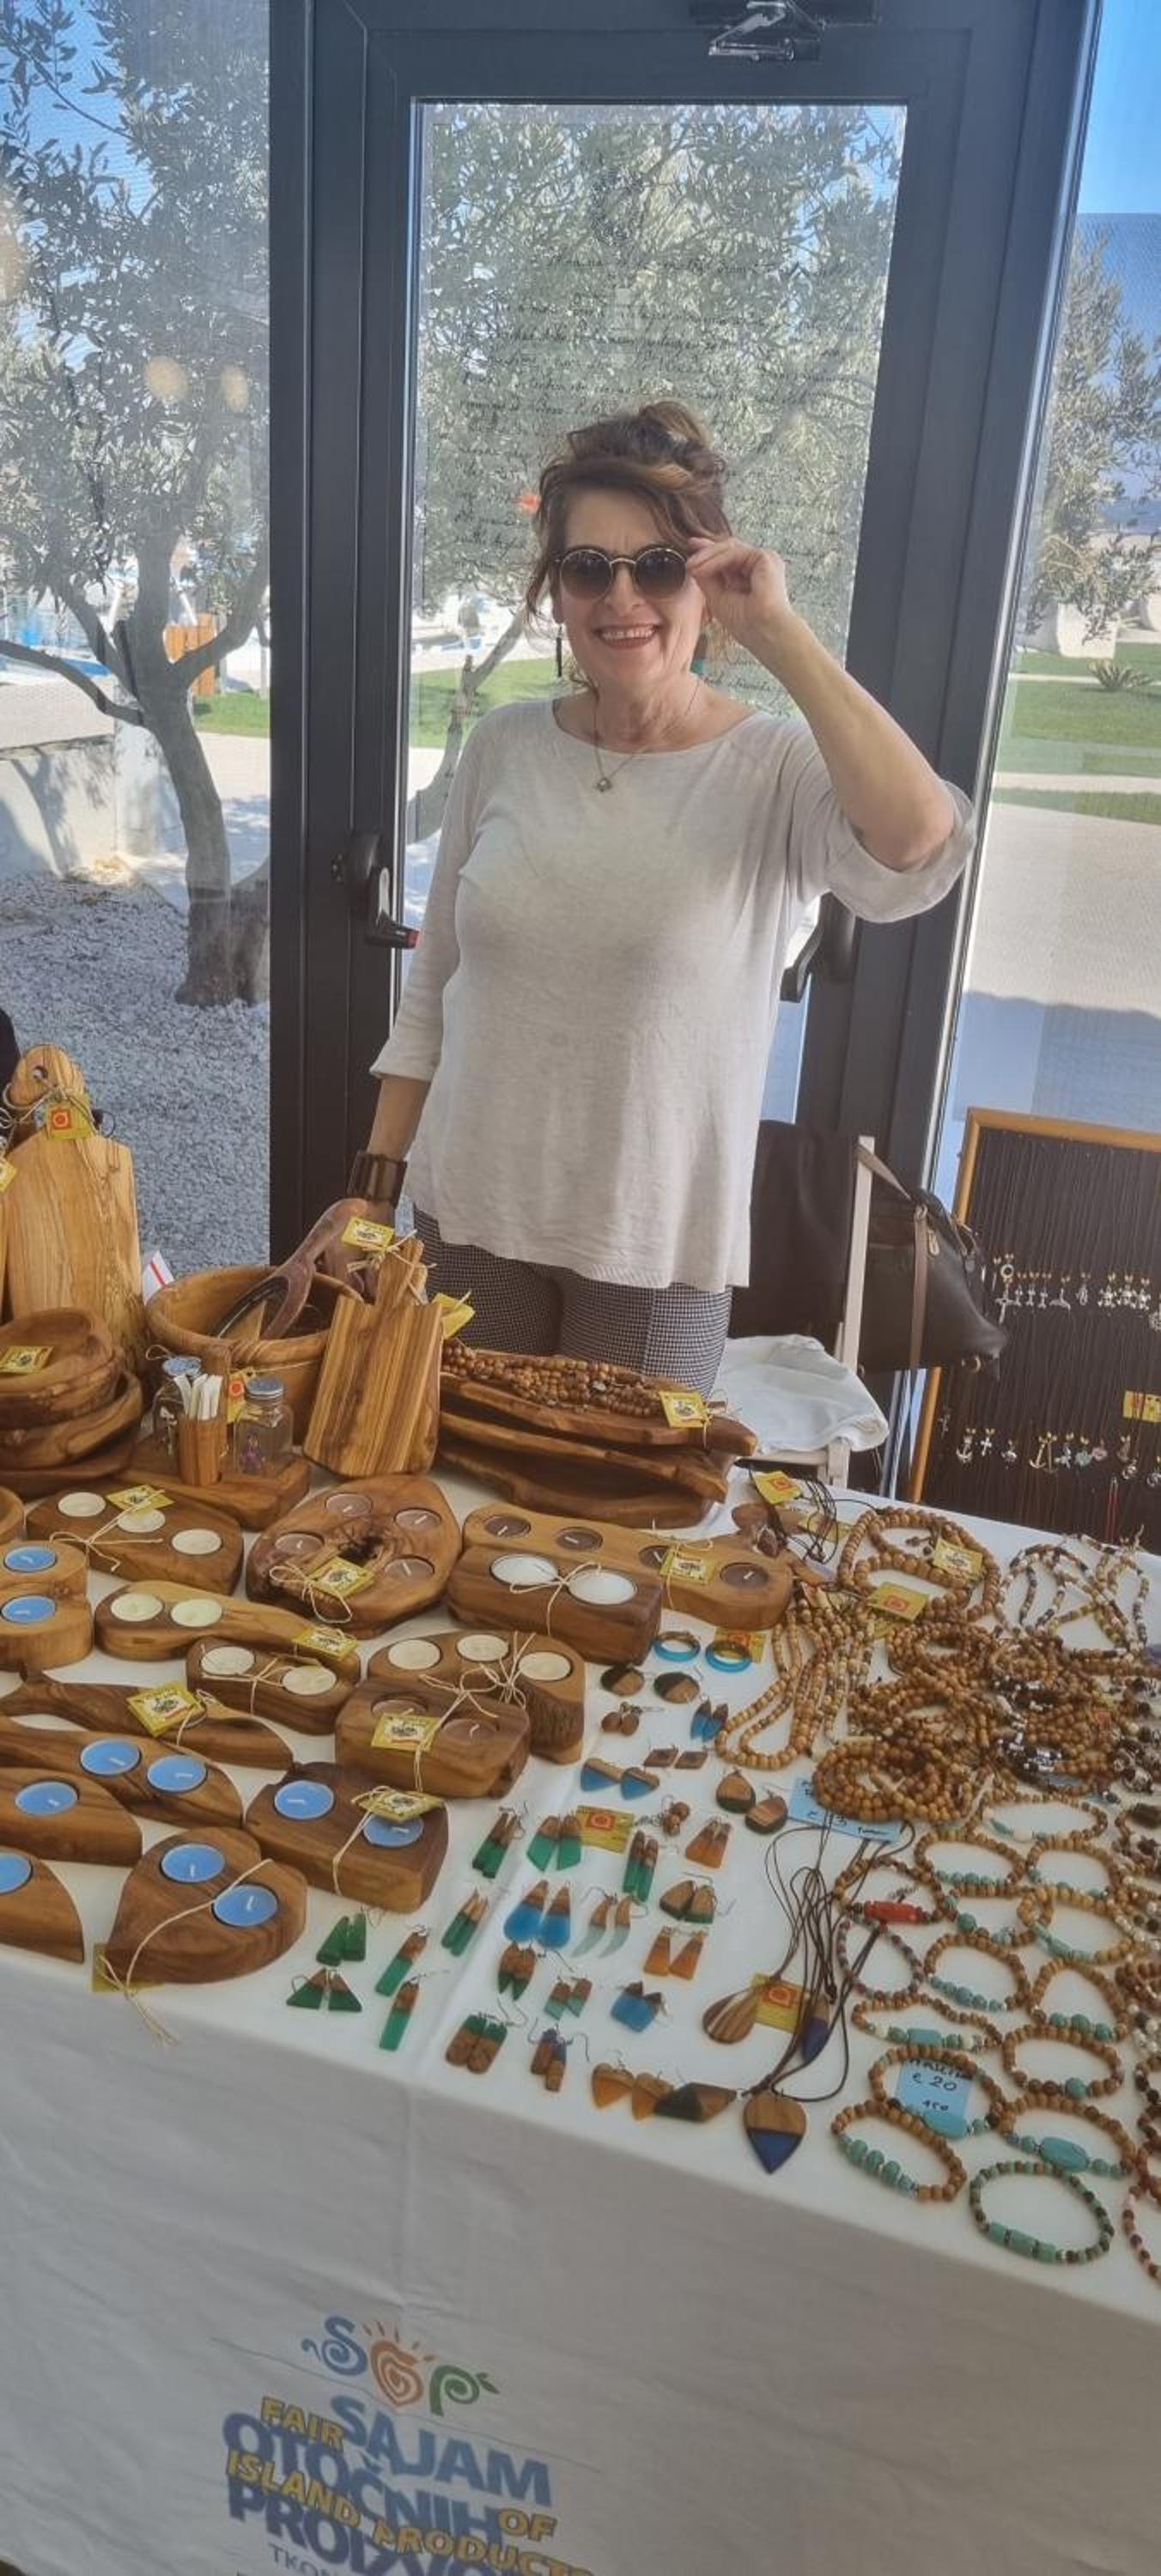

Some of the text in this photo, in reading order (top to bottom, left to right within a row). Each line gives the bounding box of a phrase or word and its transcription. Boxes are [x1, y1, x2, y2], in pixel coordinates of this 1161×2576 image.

[928, 2075, 958, 2093] 20
[226, 2446, 596, 2576] ISLAND PRODUC
[260, 2396, 558, 2542] FAIR OF
[329, 2395, 552, 2507] SAJAM
